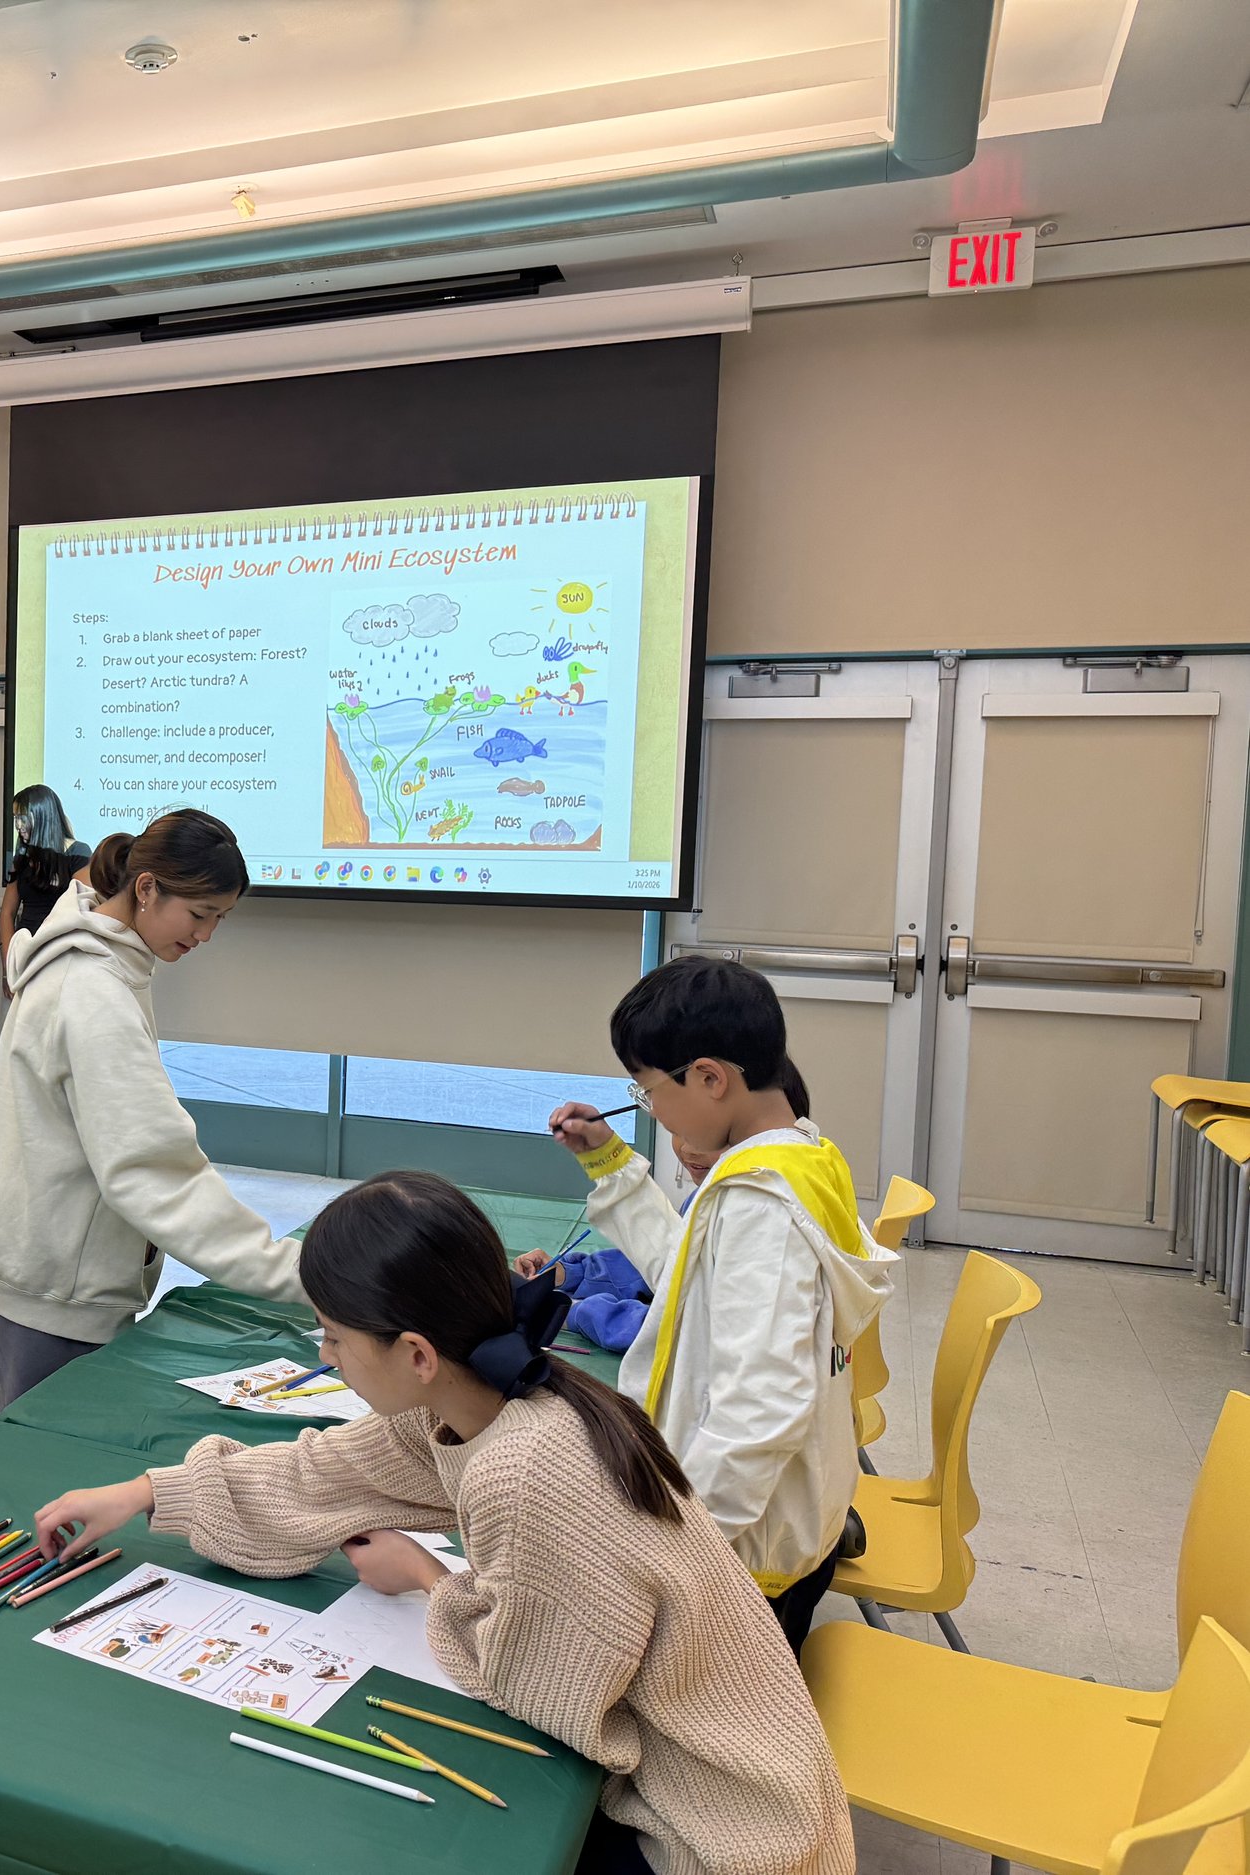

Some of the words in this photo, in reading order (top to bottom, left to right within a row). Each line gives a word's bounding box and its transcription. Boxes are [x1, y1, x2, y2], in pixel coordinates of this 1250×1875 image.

[948, 231, 1022, 288] EXIT
[152, 563, 224, 590] Design
[228, 559, 282, 579] Your
[287, 555, 334, 574] Own
[340, 550, 383, 573] Mini
[388, 542, 518, 576] Ecosystem
[561, 592, 584, 604] SUN
[72, 612, 109, 625] Steps:
[362, 617, 399, 631] clouds
[78, 634, 87, 646] 1.
[102, 632, 130, 645] Grab
[132, 633, 140, 643] a
[142, 628, 174, 643] blank
[176, 628, 210, 641] sheet
[211, 627, 226, 639] of
[228, 628, 262, 641] paper
[76, 656, 87, 668] 2.
[102, 655, 132, 667] Draw
[134, 654, 156, 666] out
[157, 654, 184, 668] your
[186, 650, 257, 665] ecosystem:
[260, 647, 308, 661] Forest?
[102, 677, 147, 690] Desert?
[150, 675, 187, 688] Arctic
[189, 674, 236, 688] tundra?
[239, 673, 249, 686] A
[329, 668, 358, 679] water
[101, 700, 181, 714] combination?
[75, 727, 86, 740] 3.
[101, 725, 161, 741] Challenge:
[163, 723, 206, 738] include
[208, 726, 216, 737] a
[218, 723, 275, 739] producer,
[456, 724, 484, 741] FISH
[100, 752, 161, 766] consumer,
[164, 750, 185, 763] and
[188, 749, 266, 766] decomposer!
[429, 766, 456, 780] SNAIL
[73, 779, 85, 791] 4.
[99, 778, 121, 791] You
[123, 780, 145, 791] can
[147, 777, 179, 791] share
[181, 779, 208, 793] your
[210, 777, 277, 793] ecosystem
[543, 794, 586, 809] TADPOLE
[99, 804, 144, 821] drawing
[146, 805, 158, 817] at
[650, 869, 661, 877] PM
[628, 880, 661, 889] 1/10/2026
